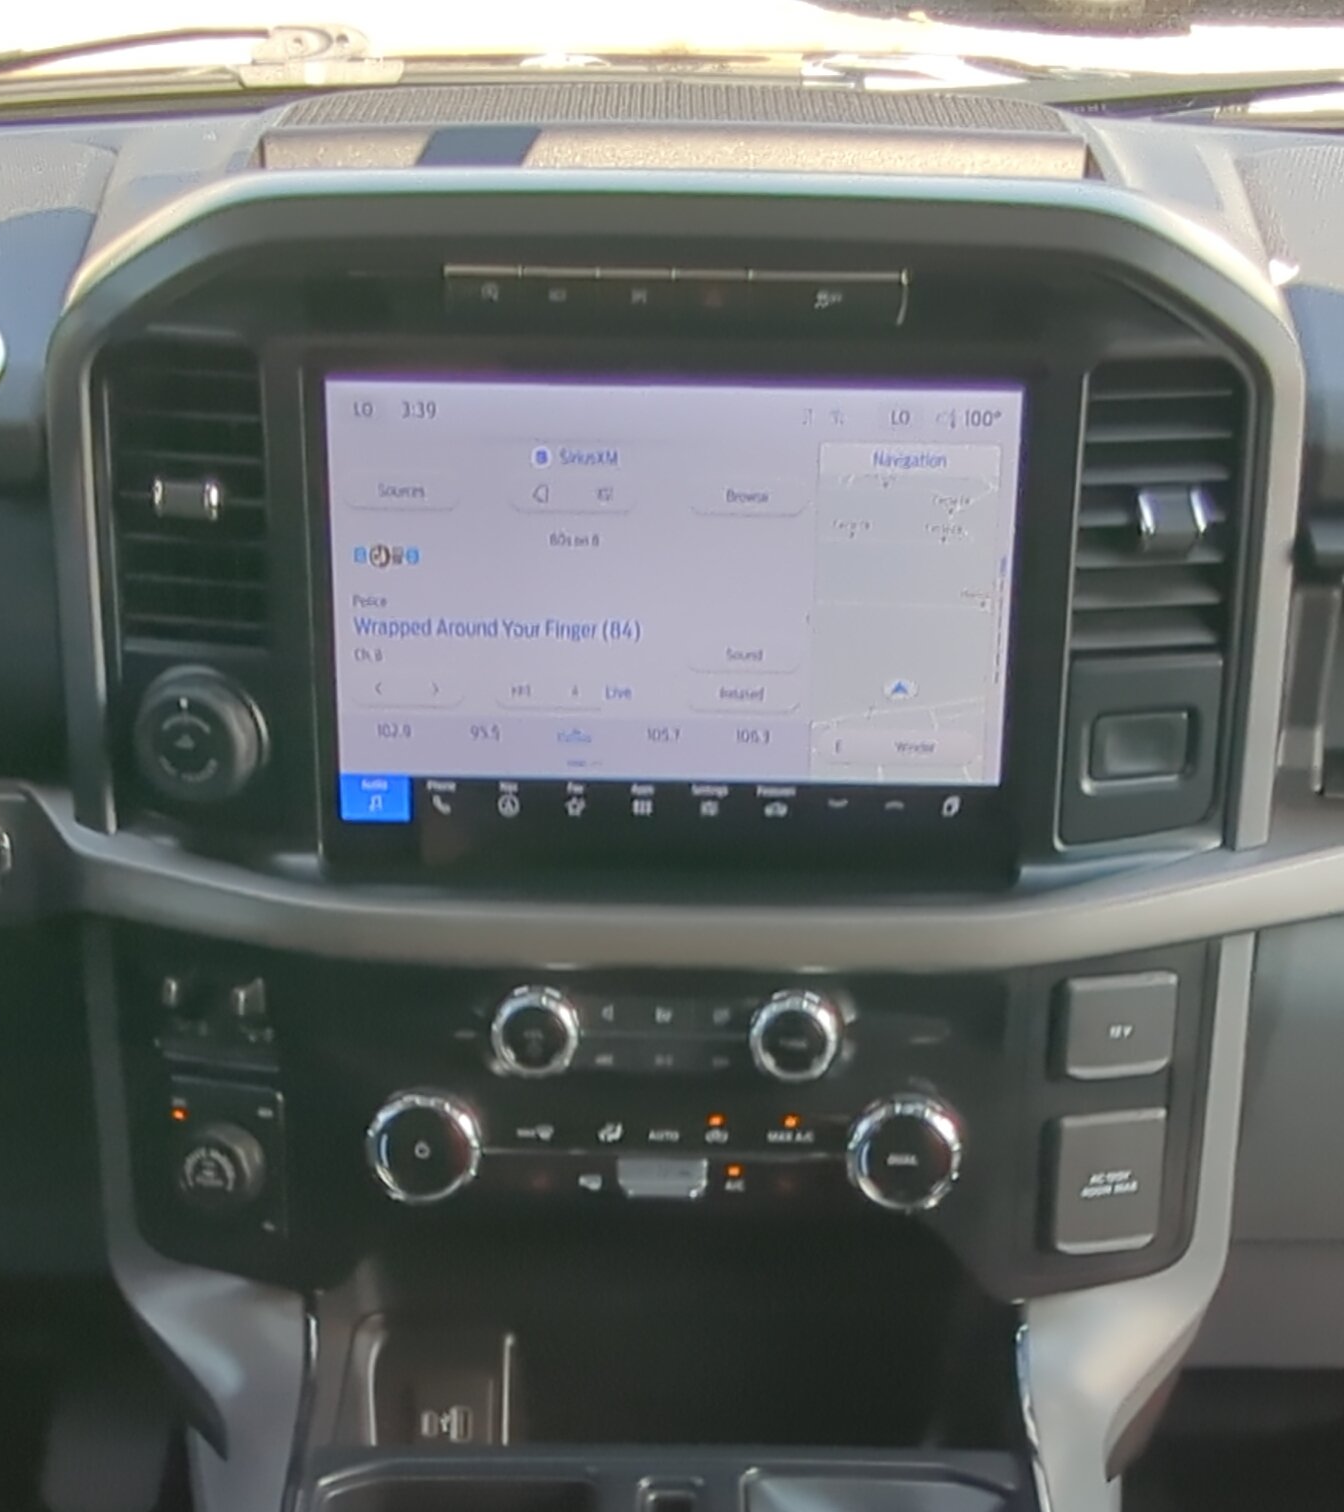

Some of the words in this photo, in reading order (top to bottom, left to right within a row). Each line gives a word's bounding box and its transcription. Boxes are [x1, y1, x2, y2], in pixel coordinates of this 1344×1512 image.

[401, 401, 437, 419] 3:39
[890, 408, 911, 427] LO
[872, 450, 948, 470] Navigation
[353, 616, 432, 639] Wrapped
[436, 618, 499, 637] Around
[502, 619, 540, 638] Your
[545, 620, 597, 643] Finger
[605, 684, 633, 700] Live
[648, 1129, 680, 1143] AUTO
